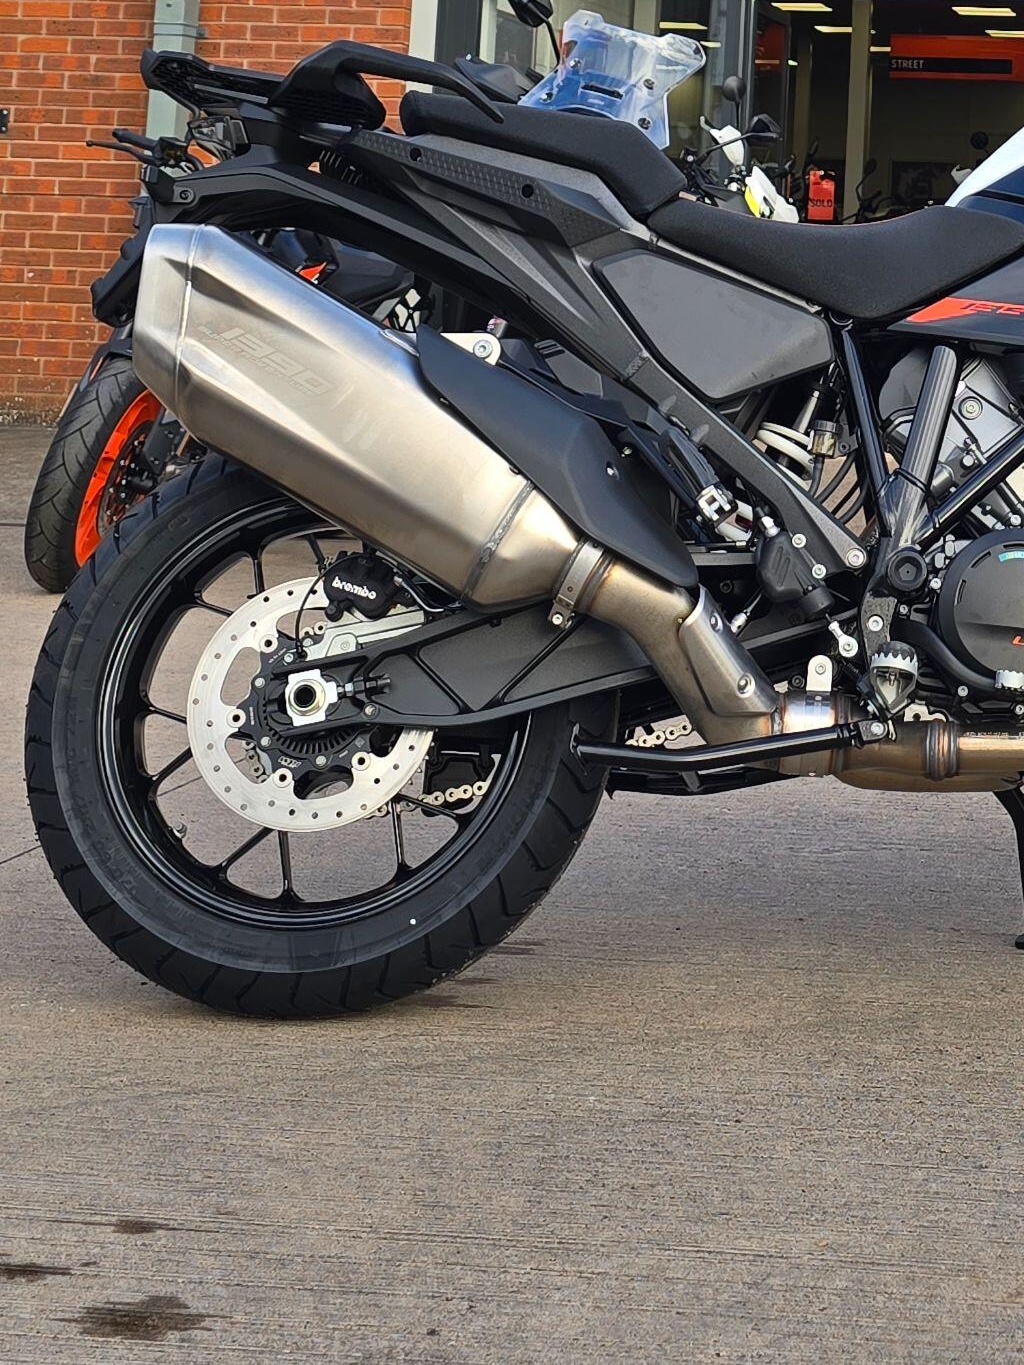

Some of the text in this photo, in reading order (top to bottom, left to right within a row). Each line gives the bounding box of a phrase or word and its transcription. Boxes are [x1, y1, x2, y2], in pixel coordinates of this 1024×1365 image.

[891, 59, 925, 69] STREET
[810, 198, 833, 208] SOLD
[332, 576, 377, 600] brembo
